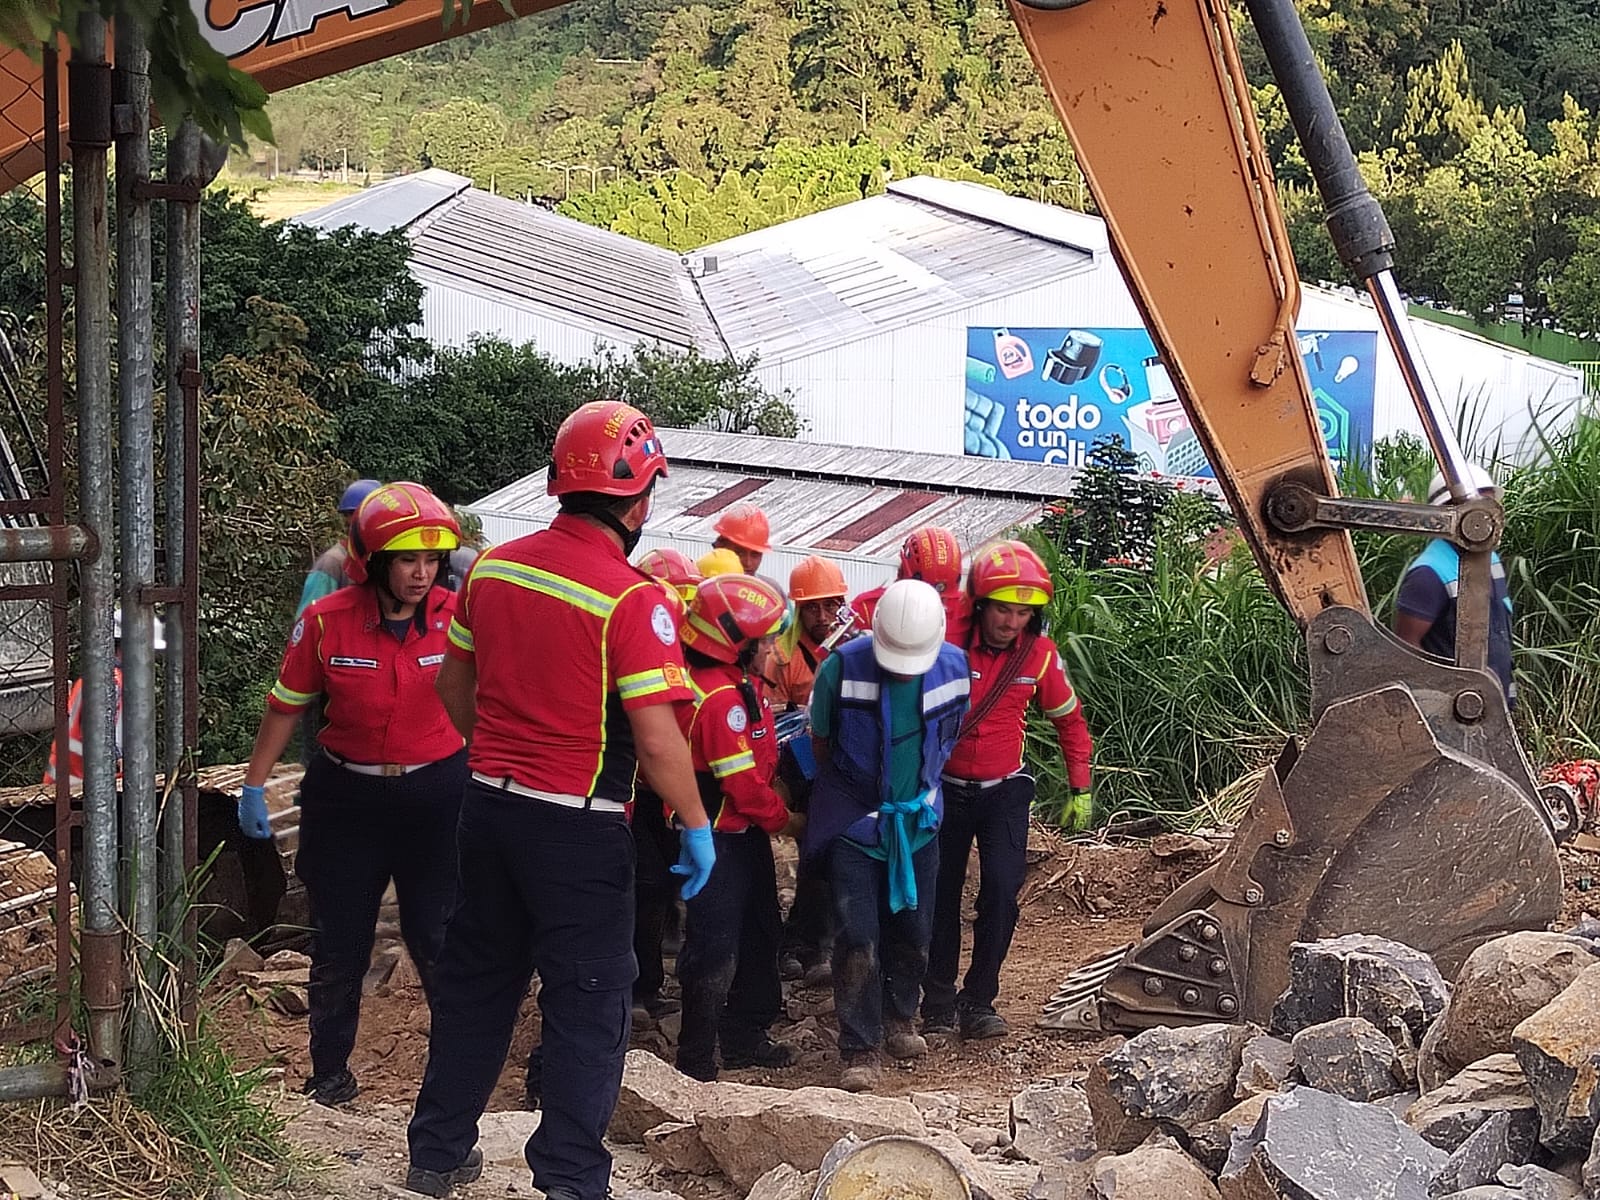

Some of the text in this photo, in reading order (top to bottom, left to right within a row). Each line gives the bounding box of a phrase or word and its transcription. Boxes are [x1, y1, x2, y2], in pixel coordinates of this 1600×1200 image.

[1016, 394, 1101, 429] todo
[1018, 430, 1067, 448] a un
[737, 587, 768, 609] CBM
